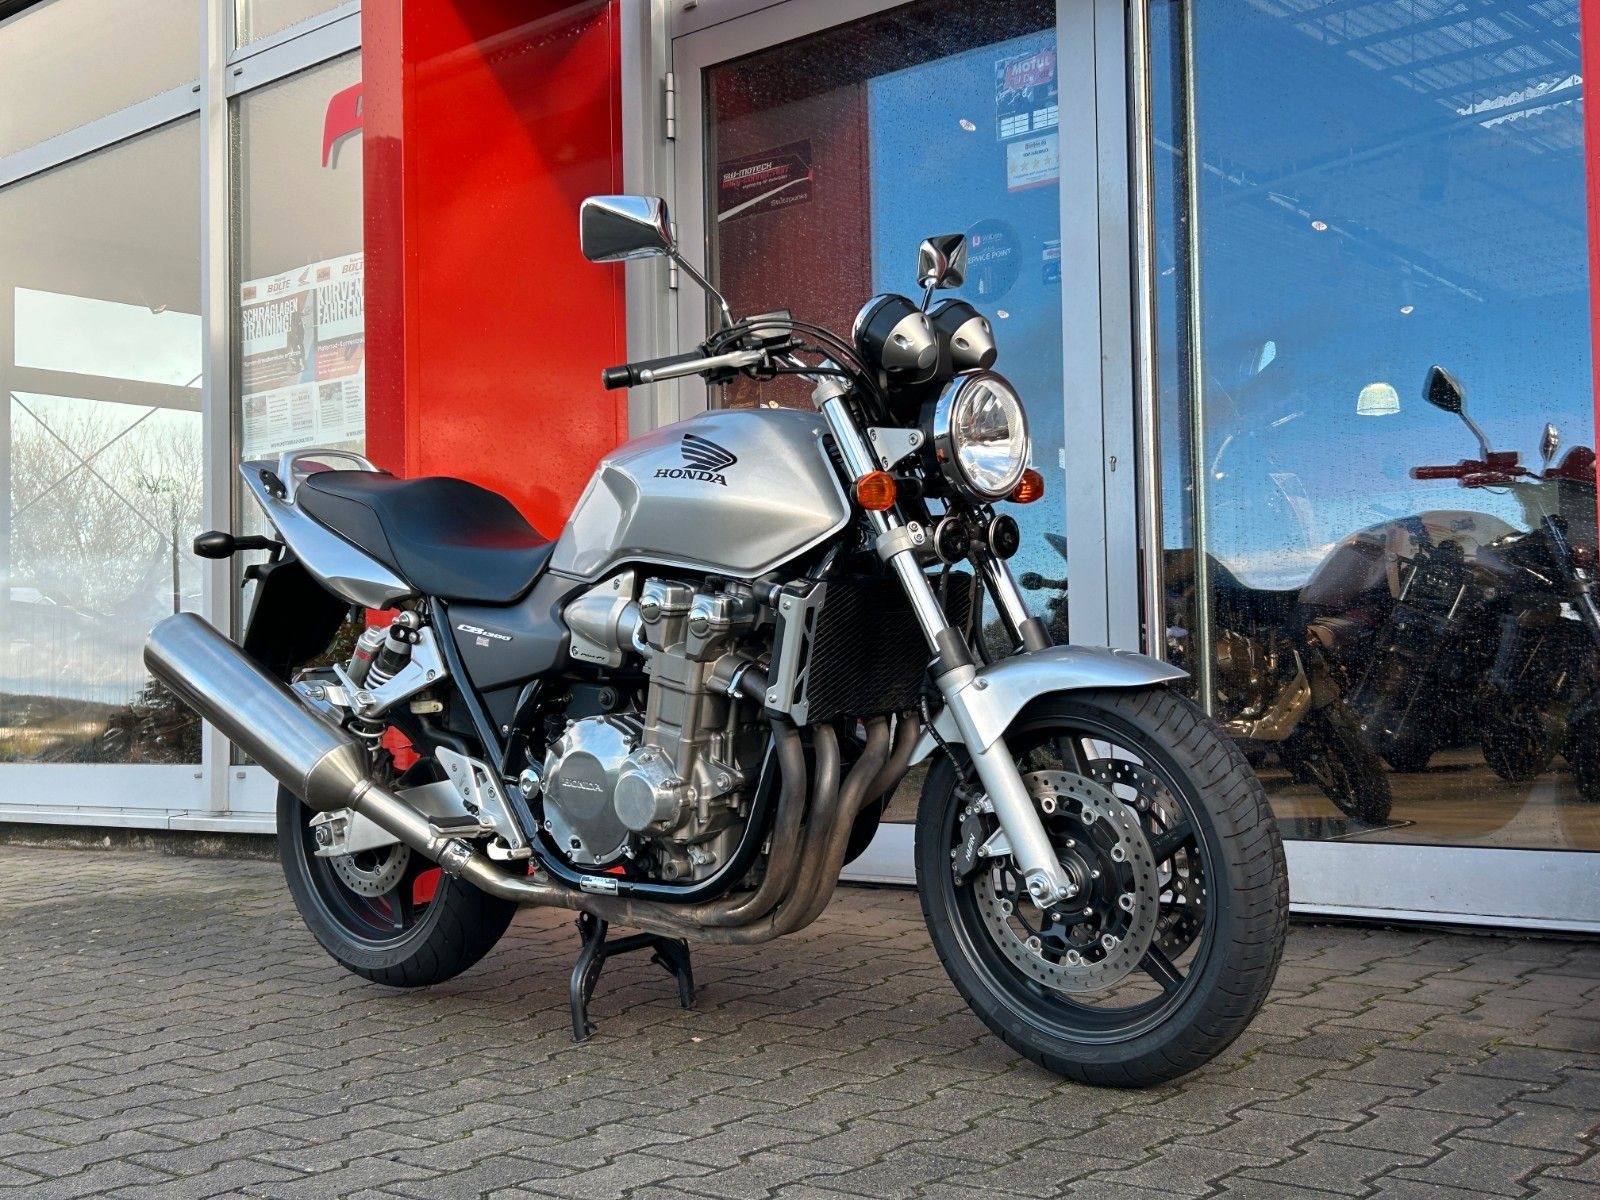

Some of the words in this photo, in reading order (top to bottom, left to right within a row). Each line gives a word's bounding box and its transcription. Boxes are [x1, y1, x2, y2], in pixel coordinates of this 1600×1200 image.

[1012, 56, 1051, 75] MOTUL
[723, 161, 773, 180] SW-MOTECH
[967, 252, 992, 264] ERVICE
[992, 247, 1012, 258] POINT
[342, 262, 364, 274] BOLT
[267, 280, 291, 293] BOLTE
[242, 297, 298, 324] SCHRÄGLAGEN
[242, 311, 292, 341] TRAINING!
[653, 467, 728, 486] HONDA
[456, 624, 512, 641] CB1300
[560, 778, 604, 793] HONDA
